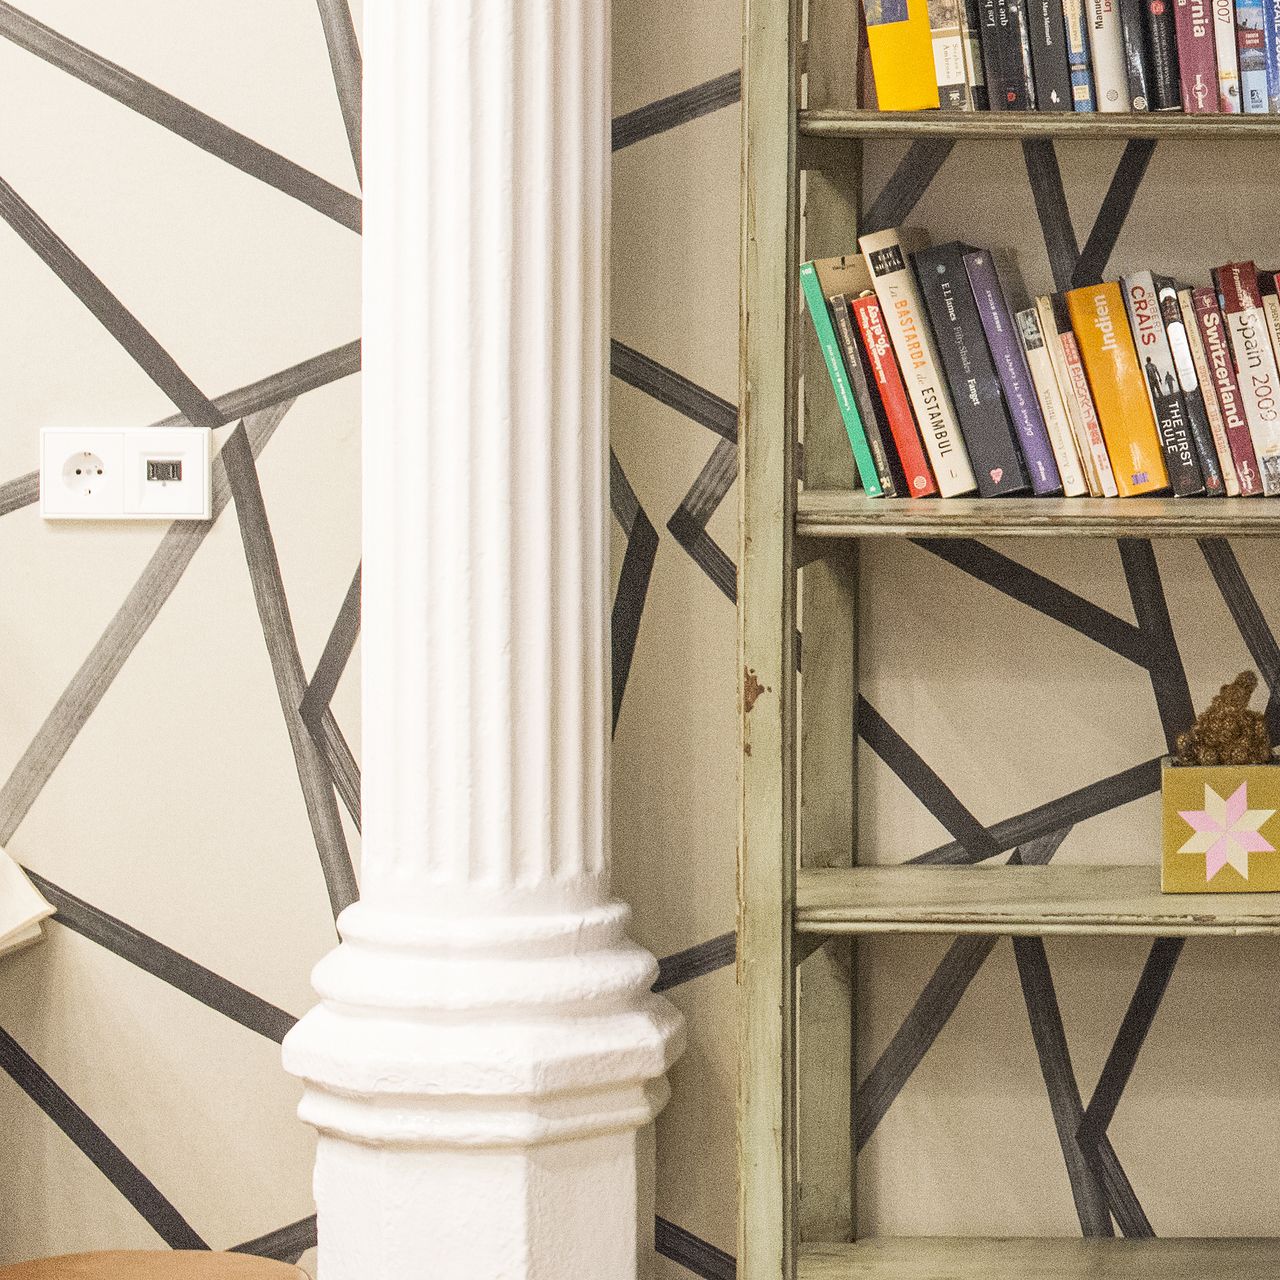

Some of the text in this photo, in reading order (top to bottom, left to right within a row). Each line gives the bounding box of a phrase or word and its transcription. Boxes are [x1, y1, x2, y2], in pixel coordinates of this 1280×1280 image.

[985, 9, 995, 26] Los
[999, 7, 1009, 25] que
[940, 281, 950, 289] E
[865, 301, 882, 324] rey
[944, 297, 958, 322] James
[1093, 293, 1116, 352] Indien
[1130, 285, 1156, 347] CRAIS
[1268, 301, 1280, 323] JOHN
[869, 322, 883, 336] el
[895, 299, 927, 370] BASTARDA
[921, 387, 954, 458] ESTAMBUL
[1202, 312, 1244, 430] Switzerland
[1238, 312, 1279, 422] Spain 2009
[964, 378, 982, 407] Fanget
[1161, 418, 1177, 454] RULE
[1168, 400, 1192, 468] THE FIRST
